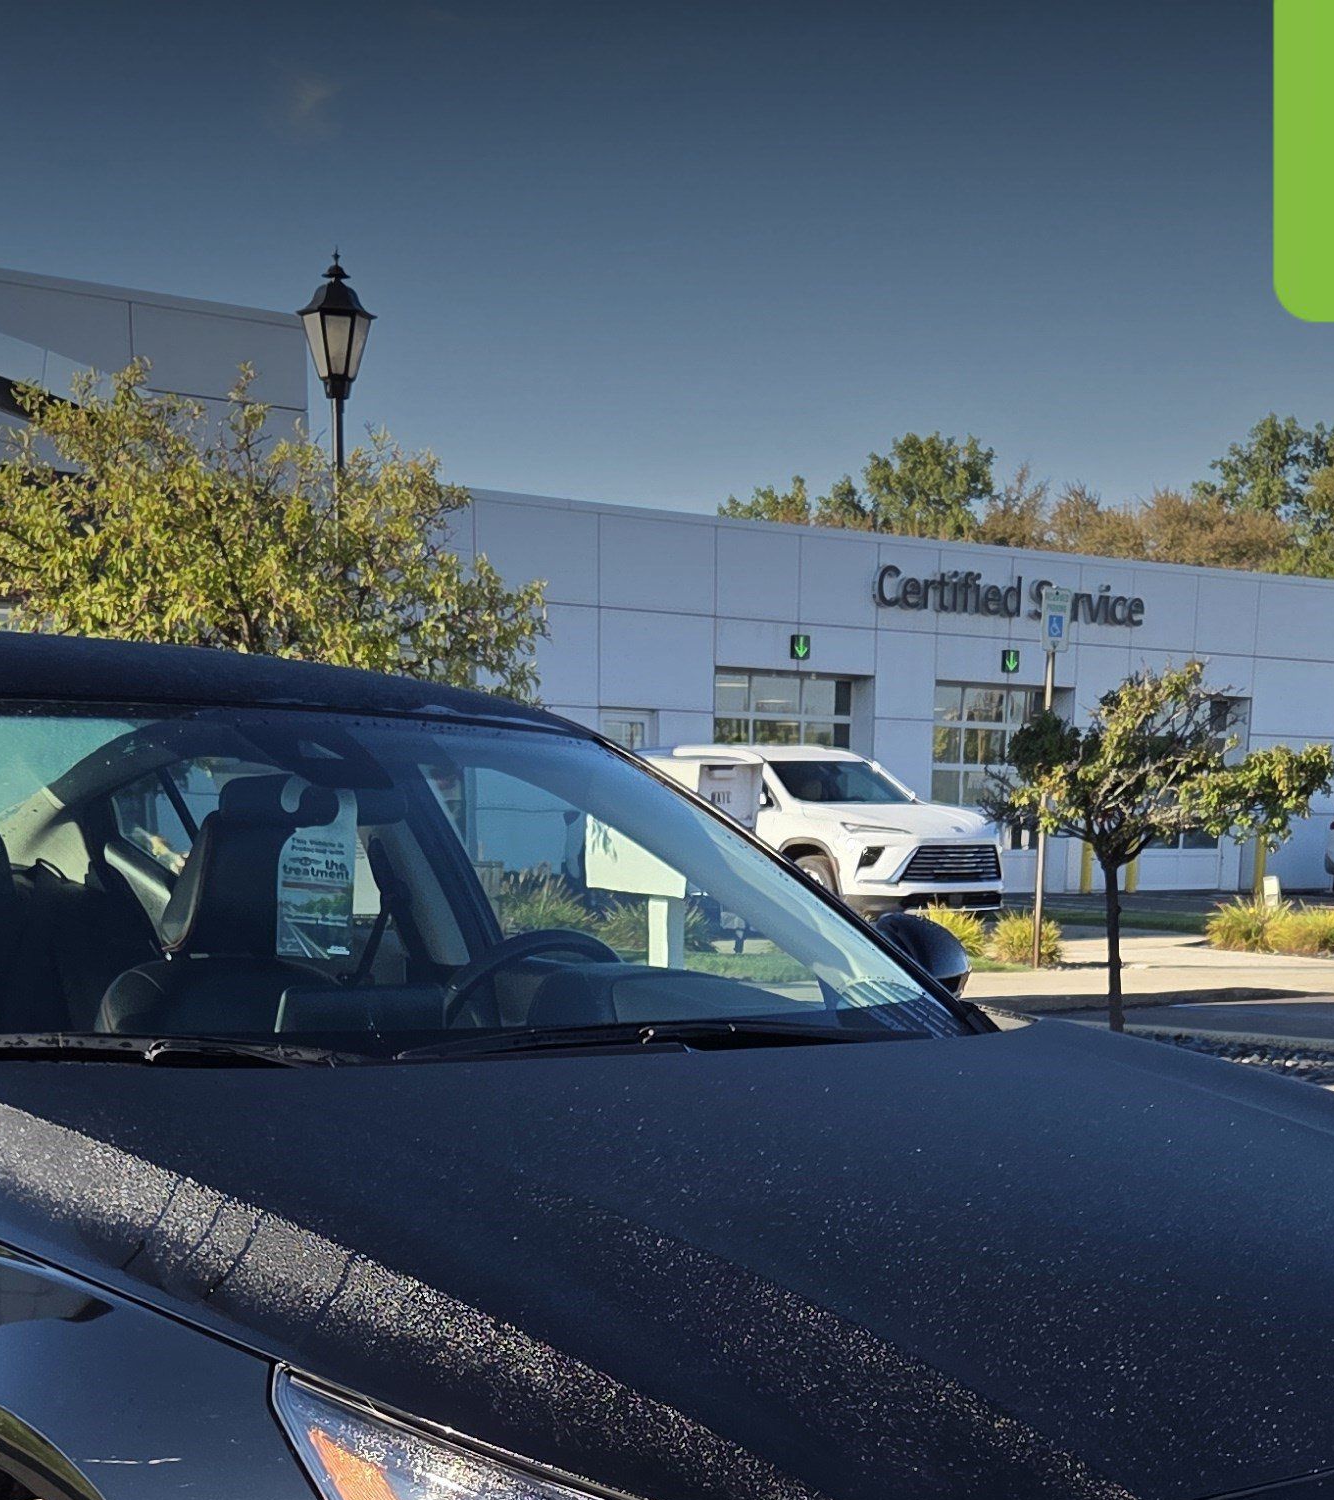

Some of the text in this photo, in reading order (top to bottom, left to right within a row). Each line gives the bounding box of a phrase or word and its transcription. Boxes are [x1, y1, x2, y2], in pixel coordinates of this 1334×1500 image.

[874, 564, 1145, 627] Certified Srvice
[283, 864, 349, 880] treatment
[325, 859, 347, 871] the
